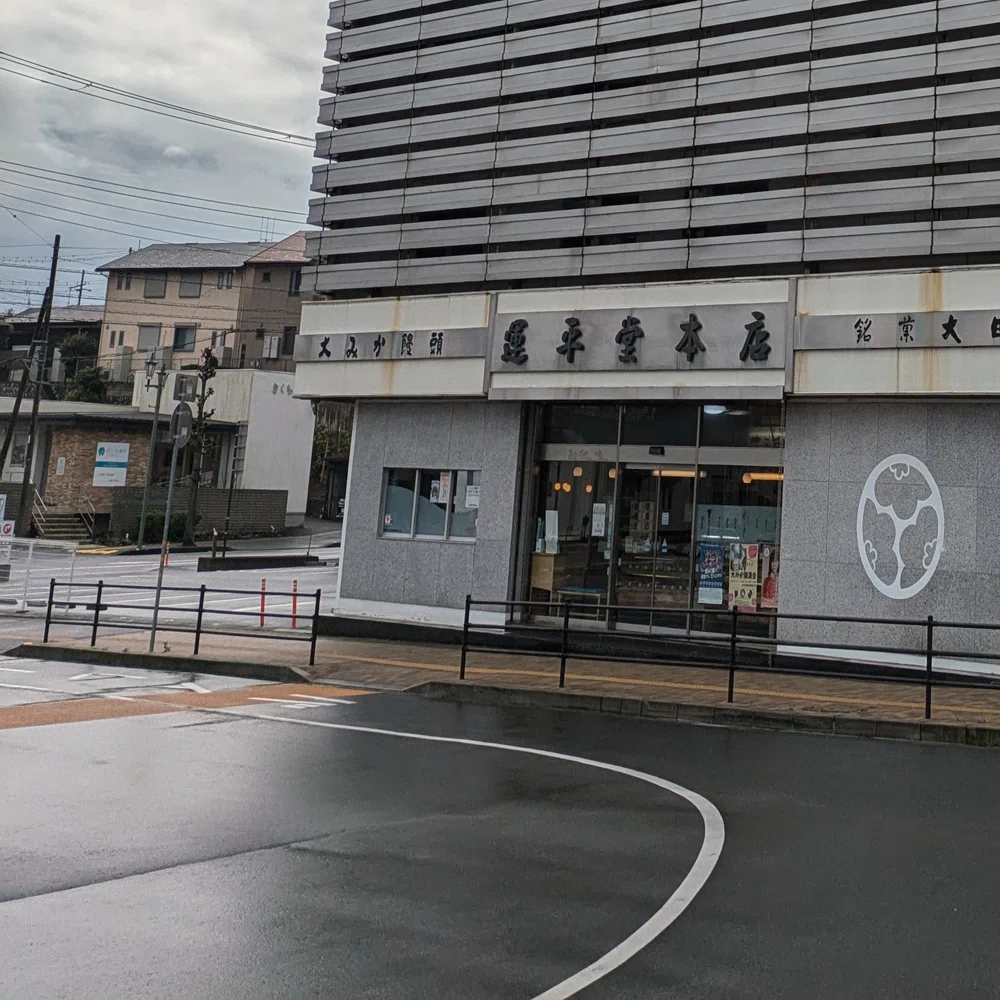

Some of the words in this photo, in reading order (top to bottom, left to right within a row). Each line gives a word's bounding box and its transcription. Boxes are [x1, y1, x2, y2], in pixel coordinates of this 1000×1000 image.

[318, 331, 444, 359] 大みか饅頭
[500, 310, 773, 365] 運平堂本店
